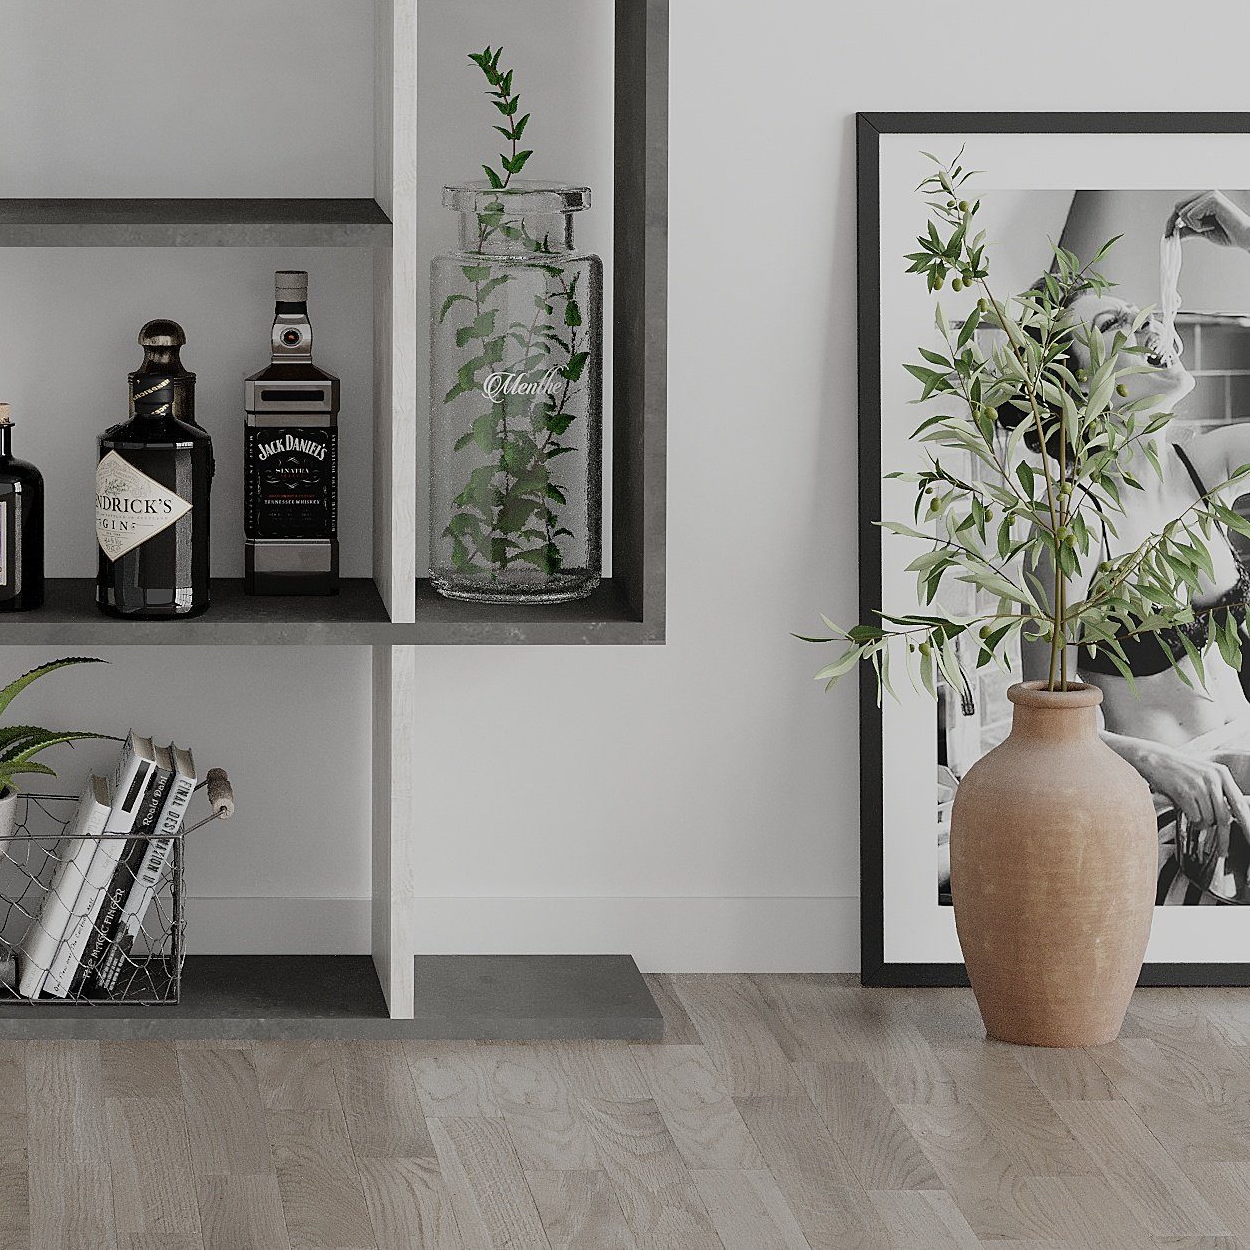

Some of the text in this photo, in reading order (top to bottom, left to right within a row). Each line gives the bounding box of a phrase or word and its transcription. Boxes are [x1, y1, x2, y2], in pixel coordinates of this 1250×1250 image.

[481, 365, 566, 404] Menthe
[257, 434, 328, 462] JACK DANIEL'S
[102, 518, 128, 531] GIN
[142, 775, 168, 827] Roald Dahl
[172, 779, 193, 807] FINAL
[148, 810, 180, 873] DESTNATION
